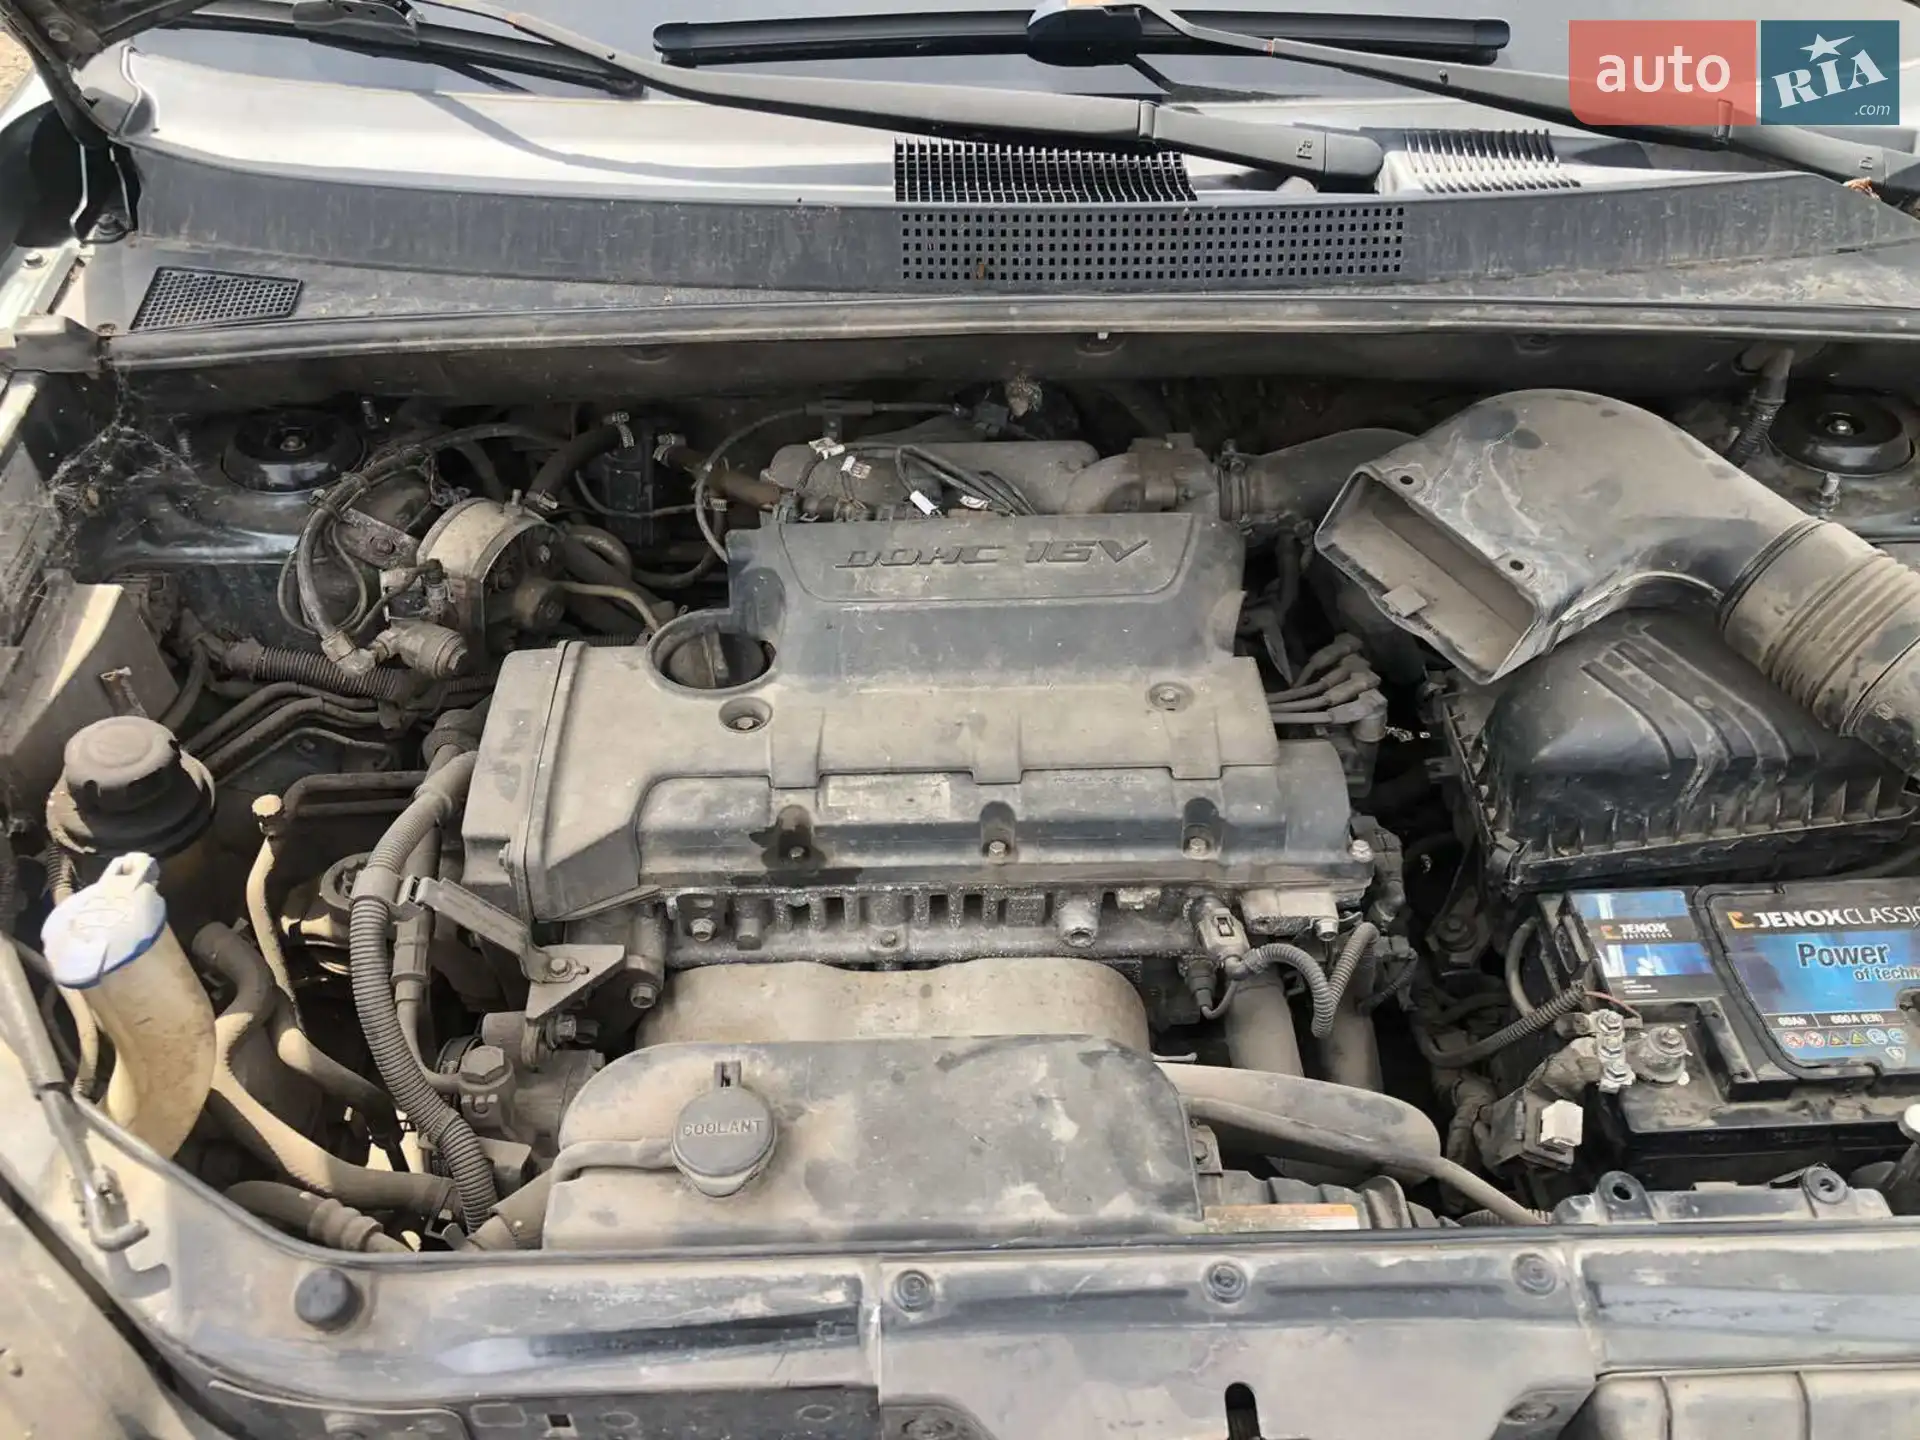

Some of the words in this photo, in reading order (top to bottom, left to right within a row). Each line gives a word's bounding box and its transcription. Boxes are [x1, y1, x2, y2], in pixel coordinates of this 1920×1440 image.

[834, 545, 1006, 569] DOHC
[1025, 539, 1149, 564] 16V
[1619, 922, 1669, 934] JENOX
[1797, 942, 1890, 968] Power
[1853, 967, 1871, 981] of
[682, 1119, 765, 1137] COOLANT
